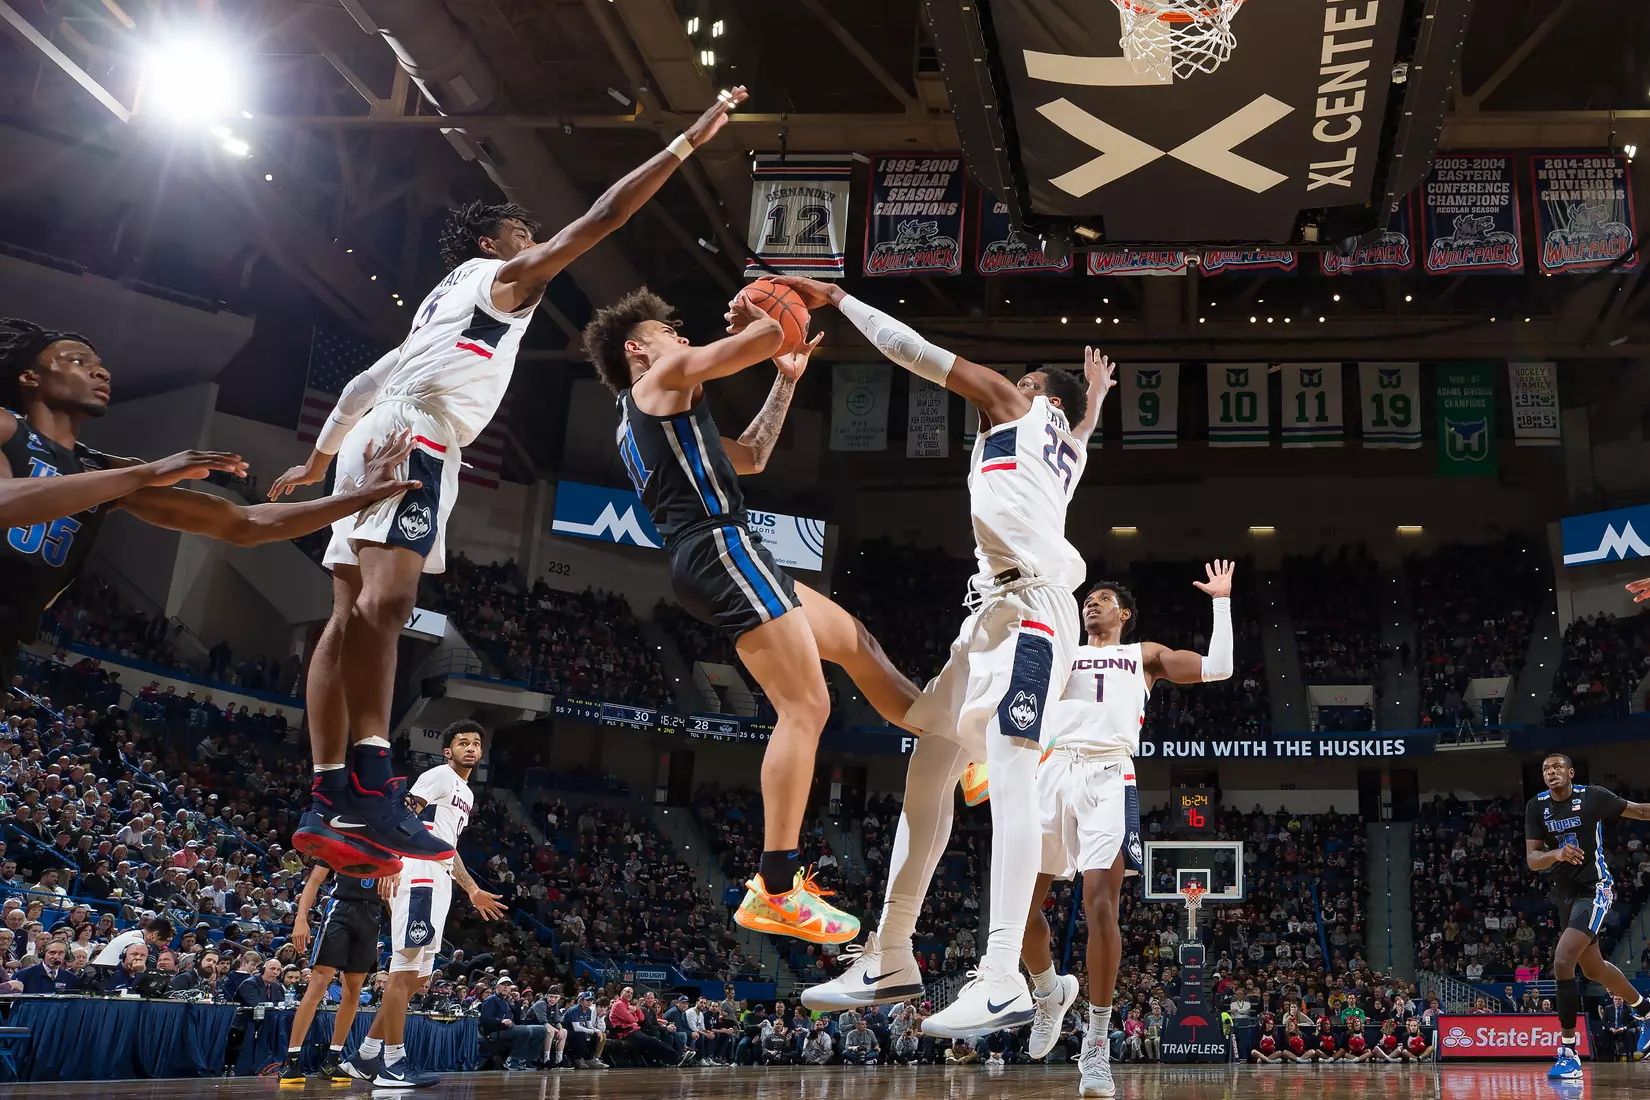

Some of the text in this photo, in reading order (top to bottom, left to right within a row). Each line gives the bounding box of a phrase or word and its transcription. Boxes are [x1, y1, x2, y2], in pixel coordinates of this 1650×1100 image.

[1306, 0, 1379, 191] XL CENTE
[878, 159, 959, 172] 1999-2000
[1435, 158, 1506, 169] 2003-2004
[1544, 158, 1616, 169] 2014-2015
[883, 173, 951, 187] REGULAR
[1437, 170, 1502, 181] EASTERN
[1538, 169, 1624, 179] NORTHEAST
[1427, 182, 1510, 193] CONFERENCE
[1550, 179, 1614, 190] DIVISION
[887, 187, 946, 201] SEASON
[1427, 194, 1509, 206] CHAMPIONS
[1541, 190, 1625, 201] CHAMPIONS
[873, 202, 959, 216] CHAMPIONS
[766, 204, 830, 246] 12
[1517, 381, 1552, 389] FAMILY
[1138, 391, 1160, 427] 9
[1219, 391, 1257, 423] 10
[1295, 390, 1329, 423] 11
[1444, 399, 1486, 408] CHAMPIONS
[1371, 393, 1412, 428] 19
[1043, 423, 1078, 496] 25
[548, 561, 571, 577] 232
[1094, 673, 1105, 703] 1
[634, 710, 649, 722] 30
[660, 715, 686, 728] 16:24
[694, 719, 709, 731] 28
[422, 728, 441, 739] 107
[1163, 741, 1205, 757] RUN
[1212, 741, 1267, 757] WITH
[1273, 740, 1312, 756] THE
[1319, 739, 1406, 756] HUSKIES
[1181, 794, 1208, 807] 16:24
[1188, 808, 1205, 828] 16
[1545, 816, 1582, 833] Tigers
[1162, 1043, 1225, 1055] TRAVELERS
